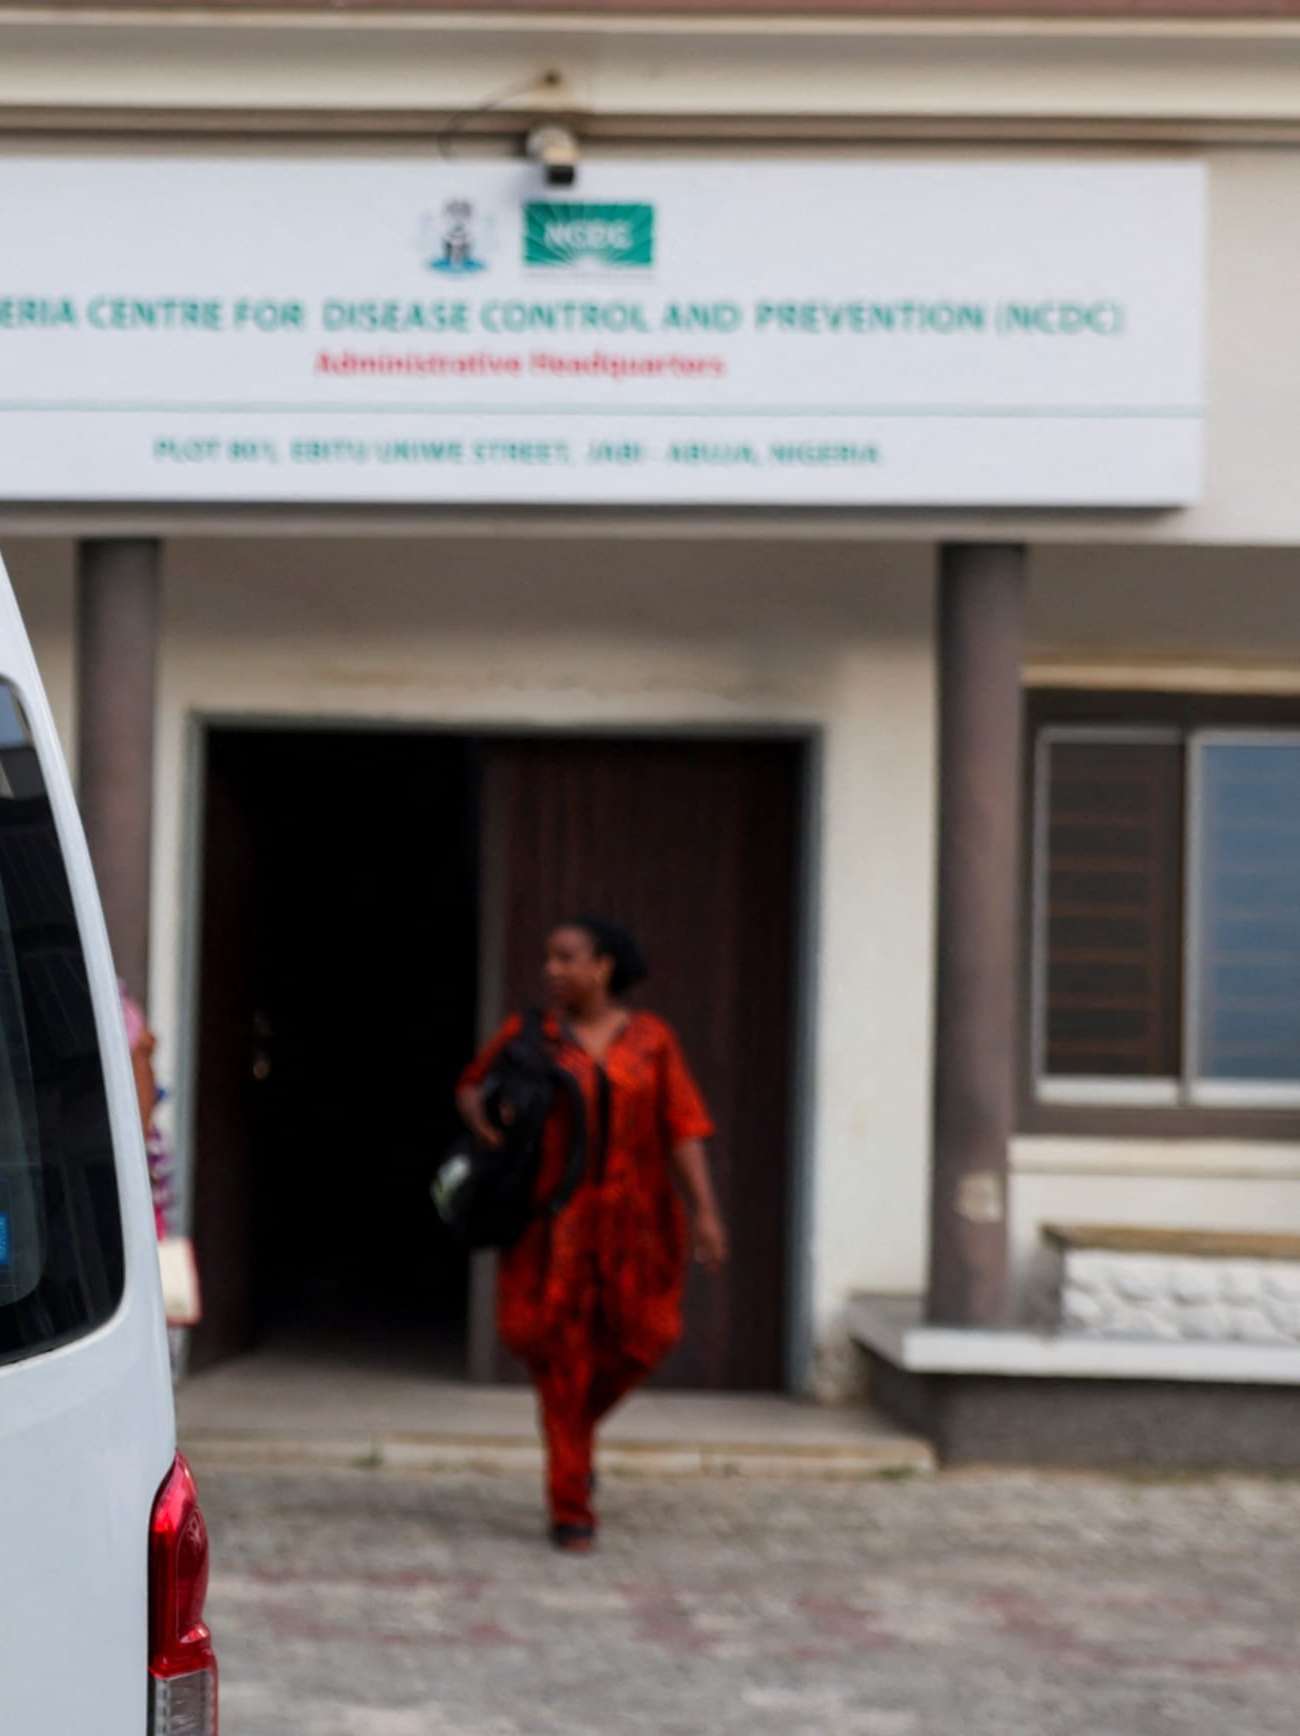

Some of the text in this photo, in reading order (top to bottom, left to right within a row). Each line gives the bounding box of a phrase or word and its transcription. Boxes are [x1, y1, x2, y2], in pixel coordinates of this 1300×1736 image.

[545, 220, 634, 249] NCDC
[87, 297, 222, 330] CENTRE
[233, 298, 305, 331] FOR
[323, 299, 472, 331] DISEASE
[481, 299, 650, 332] CONTROL
[661, 300, 741, 332] AND
[756, 301, 984, 334] PREVENTION
[995, 301, 1125, 336] (NCDC)
[314, 350, 726, 380] Administrative Headquarters
[152, 436, 221, 464] PLOT
[768, 439, 879, 466] NIGERIA
